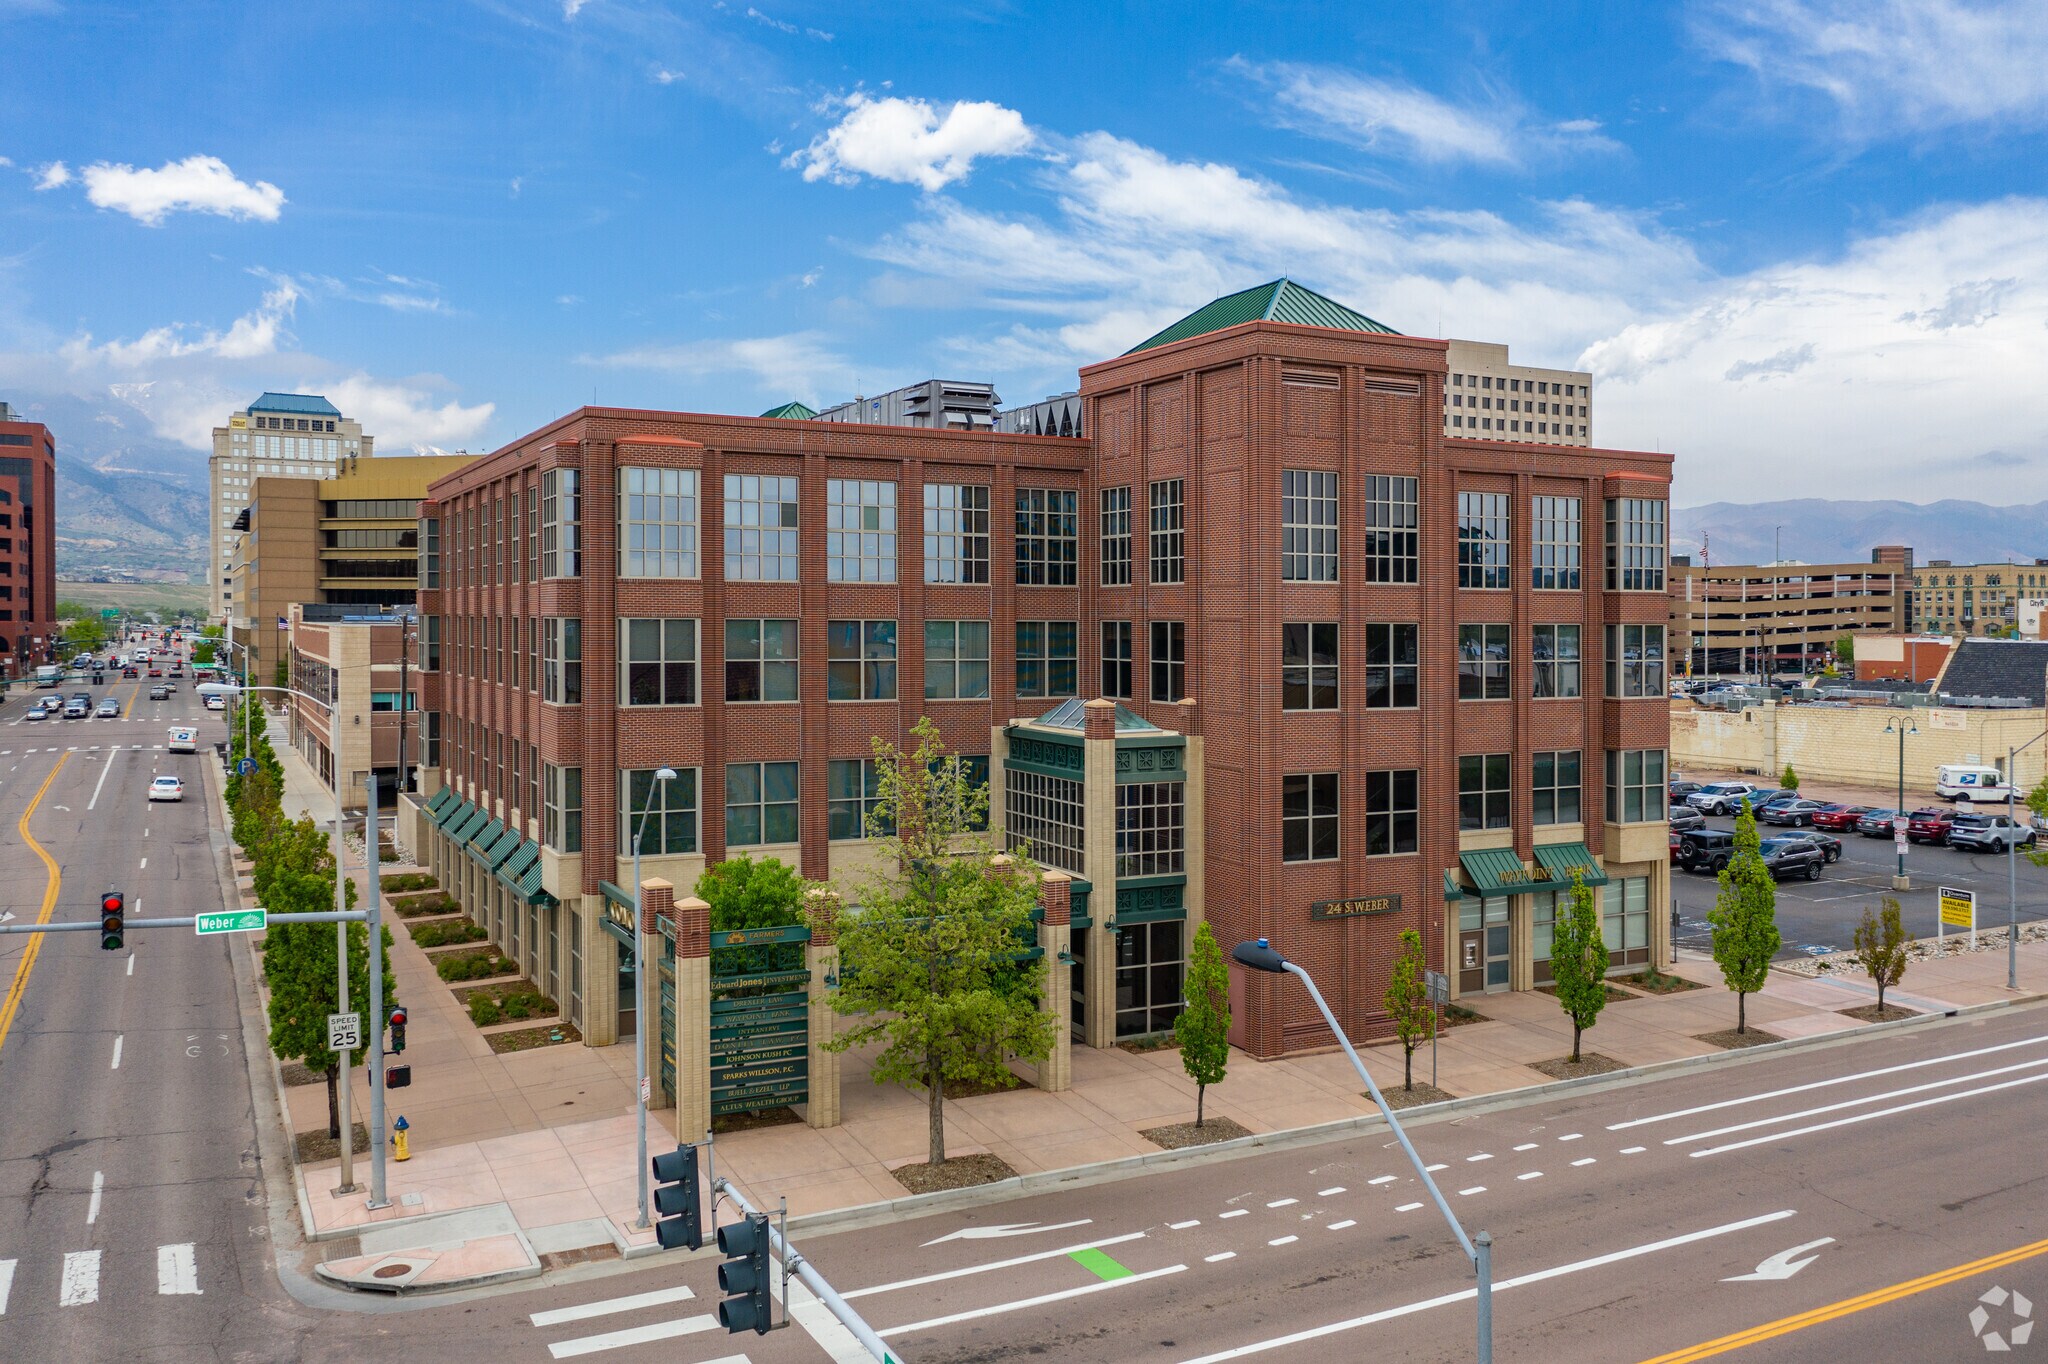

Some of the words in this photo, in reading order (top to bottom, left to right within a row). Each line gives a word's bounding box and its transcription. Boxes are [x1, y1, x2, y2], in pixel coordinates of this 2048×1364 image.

[1498, 866, 1554, 883] WAYPOINT
[1326, 903, 1342, 915] 24
[1344, 901, 1353, 914] S.
[1354, 899, 1390, 913] WEBER
[200, 917, 235, 930] Weber
[749, 929, 785, 939] FARMERS
[766, 973, 811, 984] INVESTMENTS
[733, 998, 765, 1008] DREXLER
[768, 996, 784, 1004] LAW
[331, 1016, 358, 1025] SPEED
[725, 1013, 767, 1023] WAYPOINT
[771, 1010, 791, 1018] BANK
[333, 1024, 355, 1032] LIMIT
[332, 1031, 357, 1047] 25
[726, 1053, 761, 1064] JOHNSON
[762, 1050, 782, 1059] KUSH
[783, 1049, 792, 1057] PC
[722, 1071, 748, 1080] SPARKS
[748, 1068, 782, 1077] WILLSON,
[783, 1065, 795, 1073] P.C.
[728, 1088, 748, 1097] BUELL
[720, 1103, 743, 1112] ALTUS
[745, 1100, 775, 1108] WEALTH
[776, 1096, 800, 1104] GROUP
